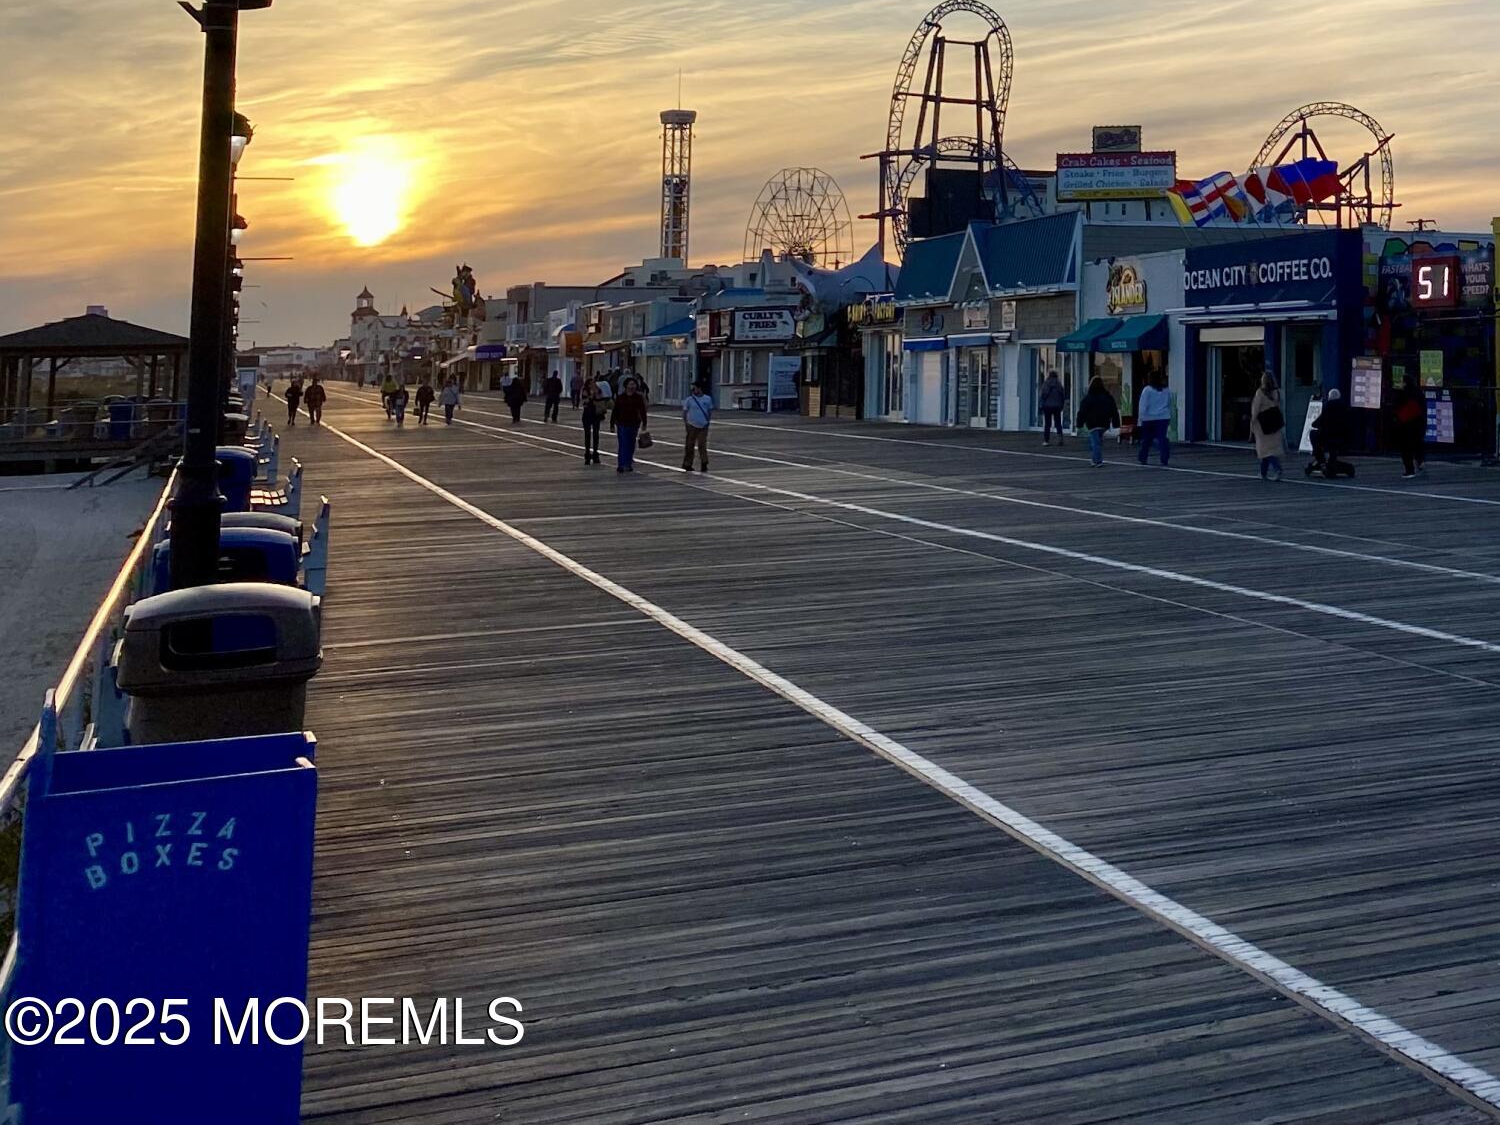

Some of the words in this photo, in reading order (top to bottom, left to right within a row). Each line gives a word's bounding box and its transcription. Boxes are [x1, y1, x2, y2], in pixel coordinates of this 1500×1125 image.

[1061, 157, 1086, 167] Crab
[1089, 156, 1121, 167] Cakes
[1130, 155, 1173, 165] Seafood
[1462, 261, 1490, 273] WHAT'S
[1184, 268, 1220, 291] OCEAN
[1222, 265, 1247, 286] CITY
[1258, 259, 1309, 283] COFFEE
[1310, 257, 1333, 279] CO.
[1465, 273, 1487, 283] YOUR
[1462, 284, 1490, 295] SPEED?
[742, 311, 784, 320] CURLY'S
[748, 320, 778, 329] FRIES
[85, 811, 236, 858] PIZZA
[85, 842, 240, 890] BOXES
